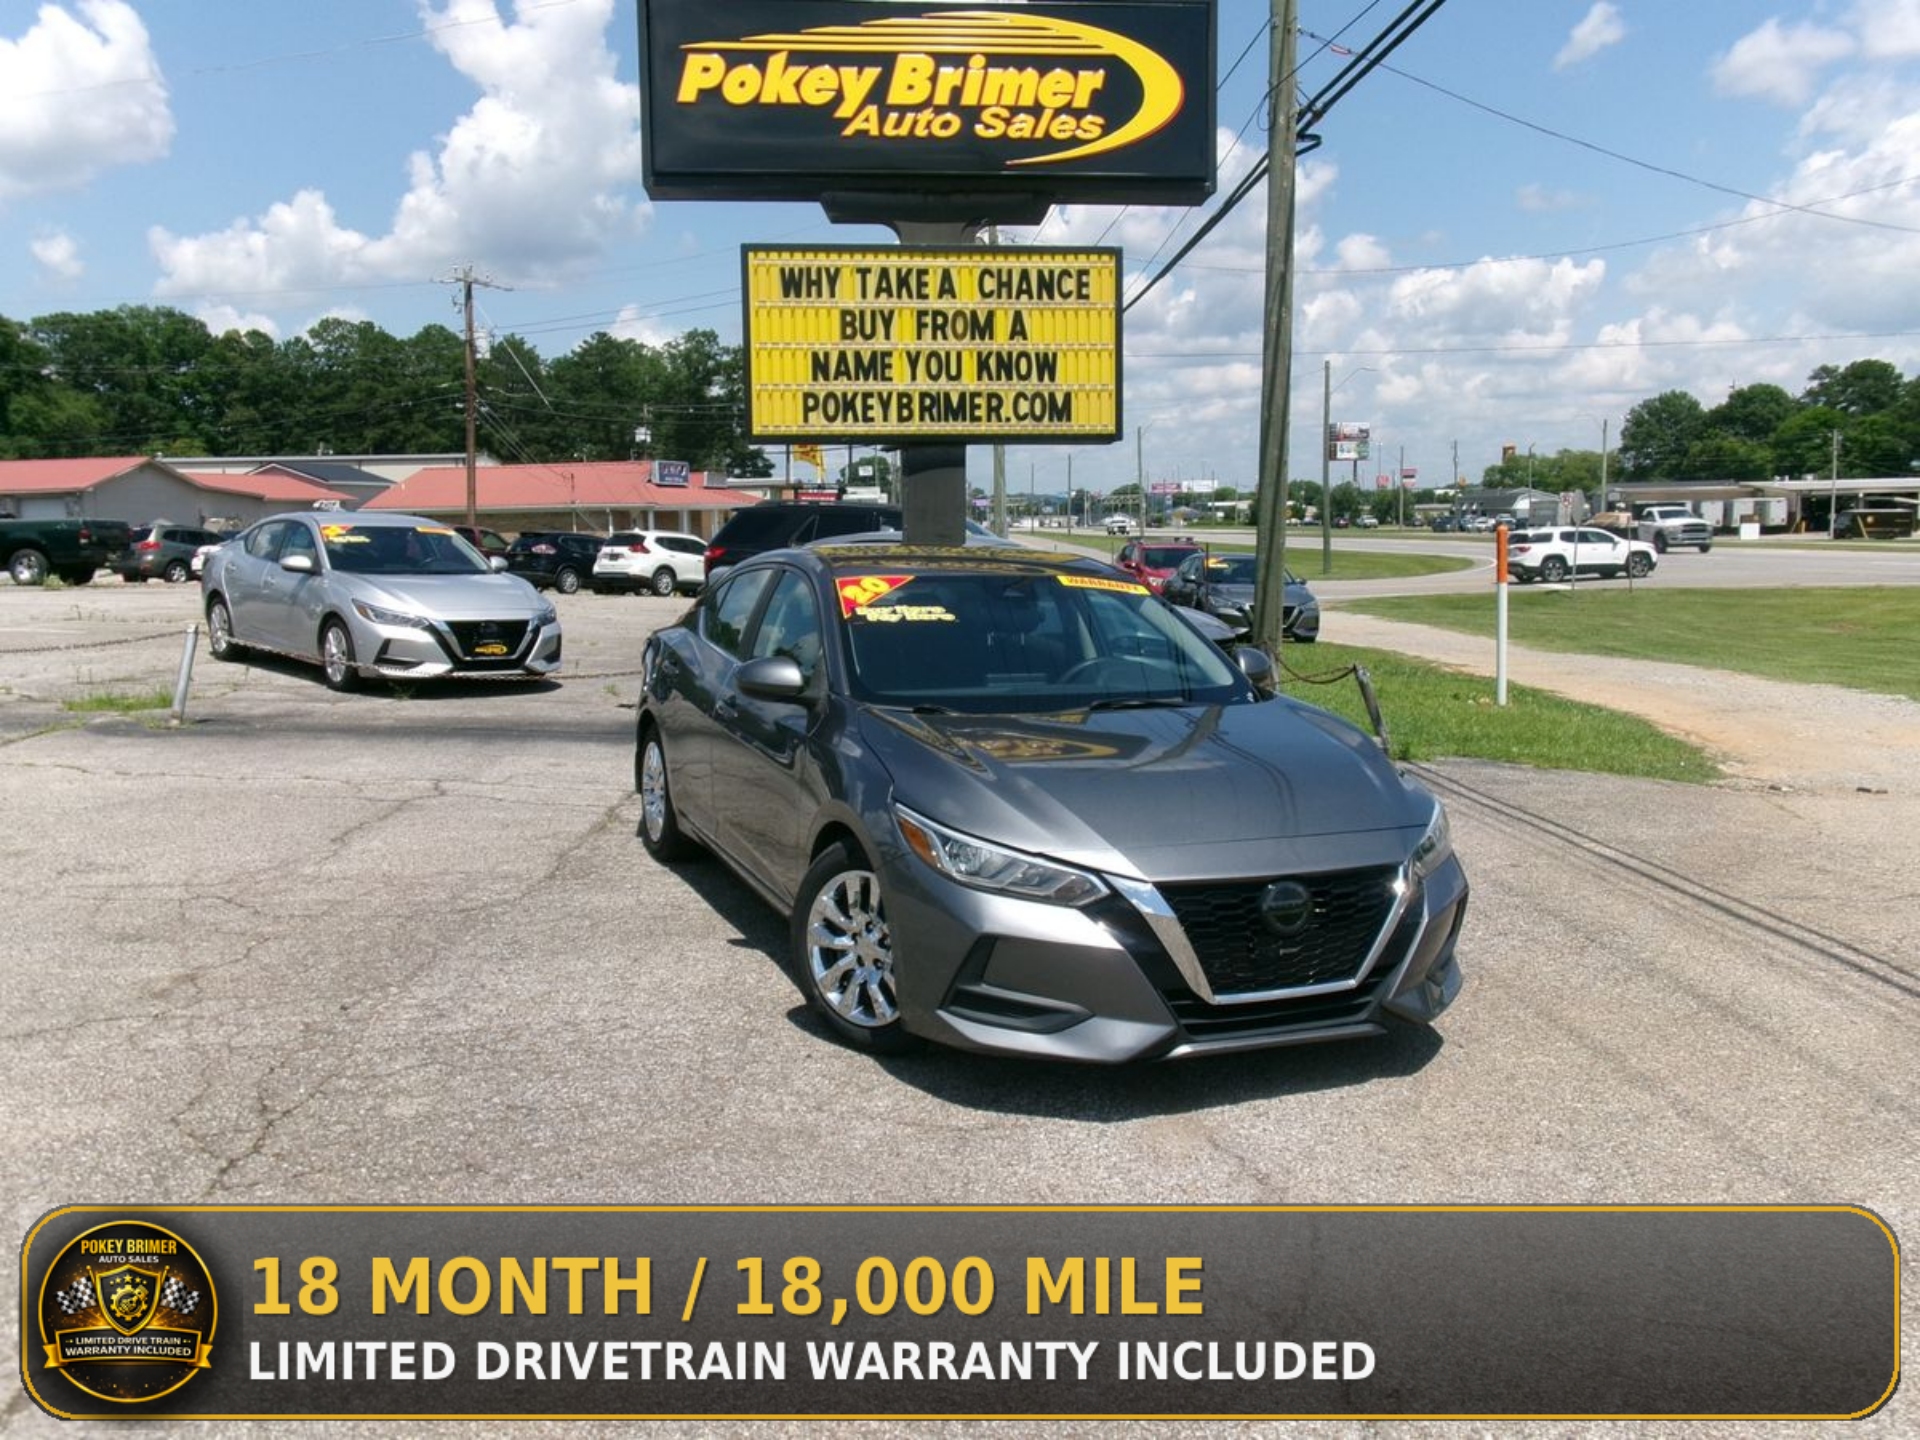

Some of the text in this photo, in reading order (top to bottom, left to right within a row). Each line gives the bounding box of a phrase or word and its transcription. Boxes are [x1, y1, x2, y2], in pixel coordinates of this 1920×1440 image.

[676, 51, 1105, 118] Pokey Brimer
[842, 106, 1105, 140] Auto Sales
[779, 267, 1090, 300] WHY TAKE A CHANCE
[840, 309, 1028, 341] BUY FROM A
[811, 350, 1058, 382] NAME YOU KNOW
[802, 391, 1072, 423] POKEYBRIMER.COM
[841, 576, 891, 605] 20
